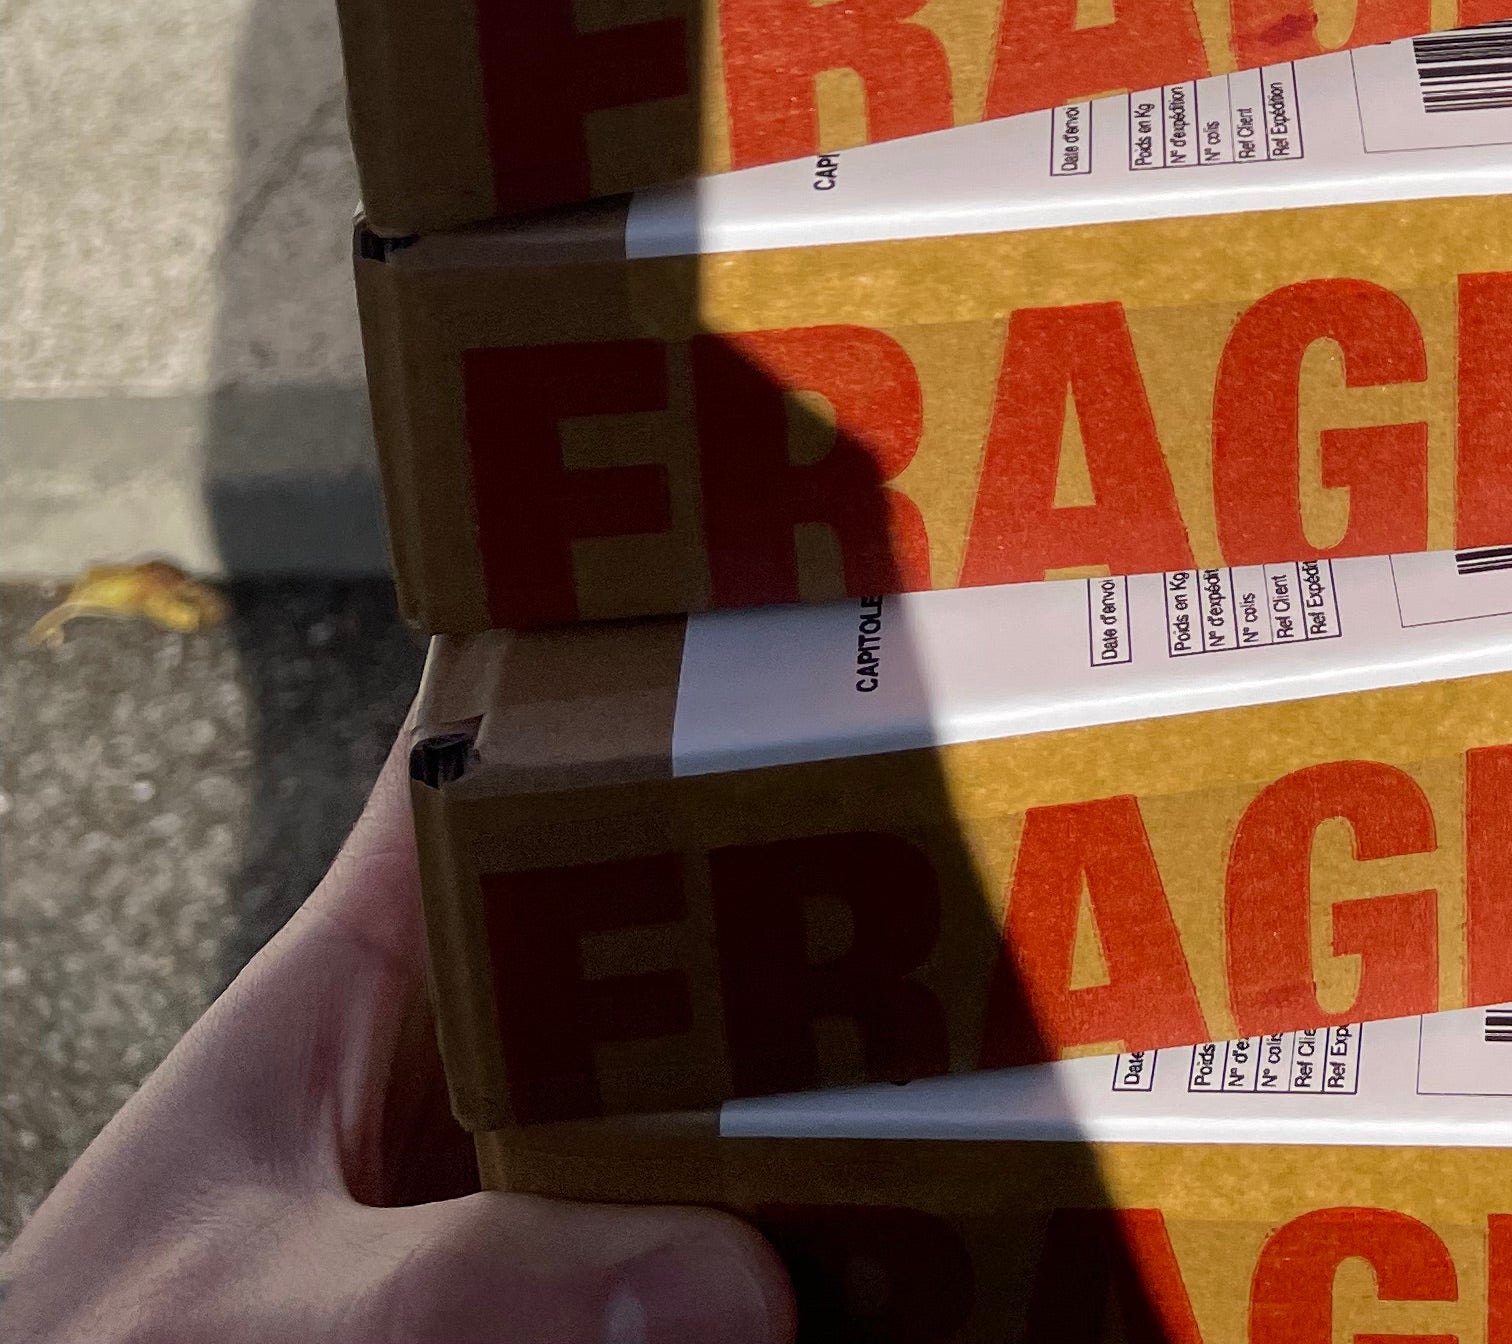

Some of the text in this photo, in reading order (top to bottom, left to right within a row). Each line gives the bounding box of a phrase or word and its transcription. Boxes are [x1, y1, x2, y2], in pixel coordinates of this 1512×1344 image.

[1135, 104, 1154, 166] Poids en Kg
[1203, 121, 1220, 145] colis
[1237, 108, 1255, 158] Ref Client
[1269, 83, 1291, 156] Ref Expédition
[1061, 146, 1078, 171] Date
[1100, 579, 1118, 659] Date d'envoi
[1170, 572, 1191, 650] Poids en Kg
[1240, 593, 1257, 622] colis
[1273, 575, 1294, 638] Ref Client
[1311, 612, 1327, 634] Ref
[1124, 1051, 1144, 1085] Date
[1195, 1044, 1216, 1086] Poids
[1295, 1062, 1313, 1088] Ref
[1328, 1062, 1346, 1088] Ref
